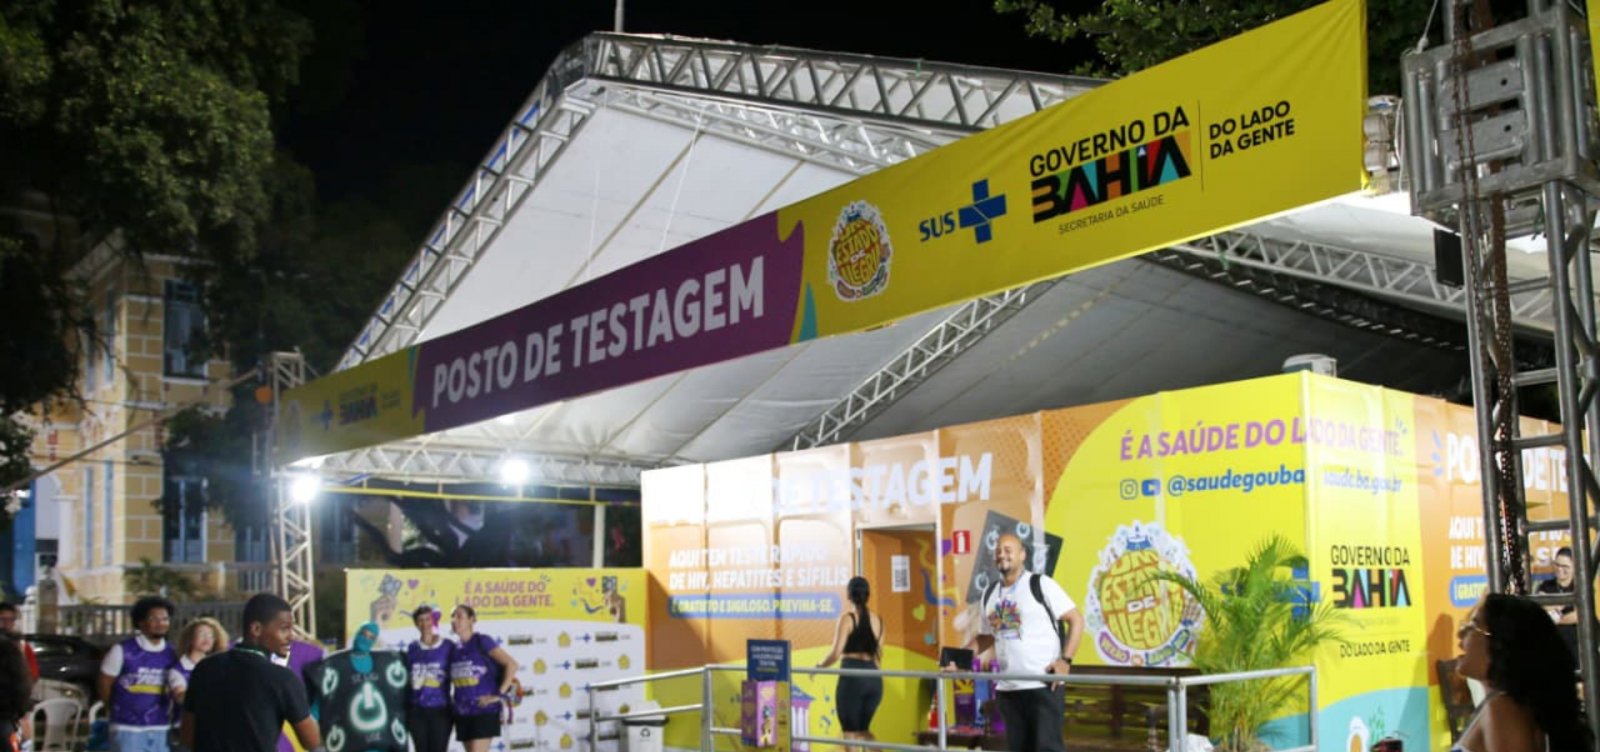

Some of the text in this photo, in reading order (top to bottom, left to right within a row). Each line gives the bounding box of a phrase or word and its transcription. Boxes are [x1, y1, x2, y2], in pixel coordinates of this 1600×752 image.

[1029, 104, 1191, 177] GOVERNO DA
[1208, 100, 1292, 140] DO LADO
[1209, 118, 1295, 160] DA GENTE
[1030, 132, 1192, 224] BAHIA
[918, 211, 956, 243] SUS
[1057, 193, 1165, 236] SECRETARIA DA SAÚDE
[836, 222, 880, 268] ESTADO
[432, 255, 765, 408] POSTO DE TESTAGEM
[1120, 429, 1134, 461] É
[1136, 434, 1153, 459] A
[1157, 420, 1241, 457] SAÚDE
[1245, 418, 1286, 448] DO
[670, 550, 700, 567] AQUI
[1330, 544, 1411, 567] GOVERNO DA
[528, 580, 547, 593] DO
[669, 573, 685, 590] DE
[713, 567, 784, 591] HEPATITES
[1331, 568, 1412, 610] BAHIA
[493, 595, 510, 608] DA
